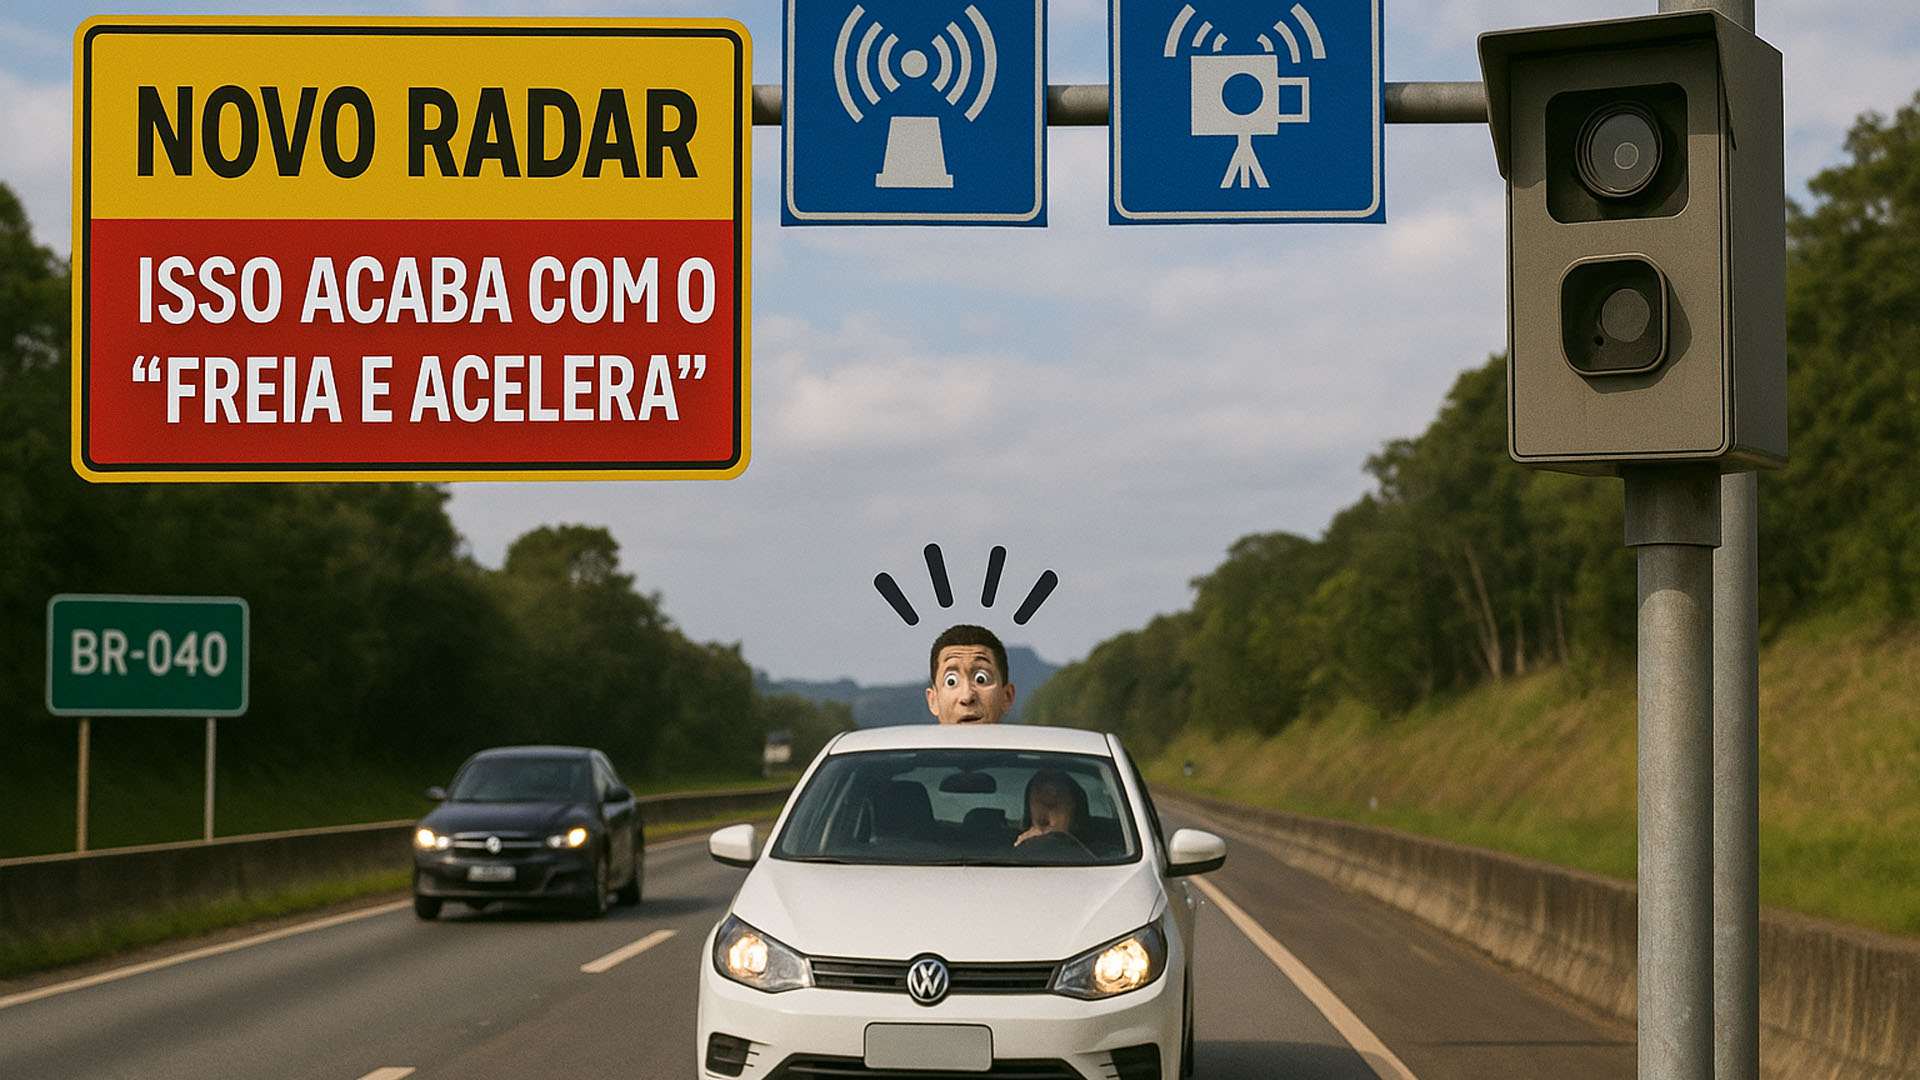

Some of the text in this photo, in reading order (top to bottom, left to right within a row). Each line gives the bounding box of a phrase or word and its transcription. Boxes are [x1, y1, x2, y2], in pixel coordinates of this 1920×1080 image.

[136, 83, 700, 179] NOVO RADAR
[138, 255, 717, 325] ISSO ACABA COM O
[131, 354, 708, 424] “FREIA E ACELERA”
[71, 629, 228, 677] BR-040
[910, 960, 946, 999] VW
